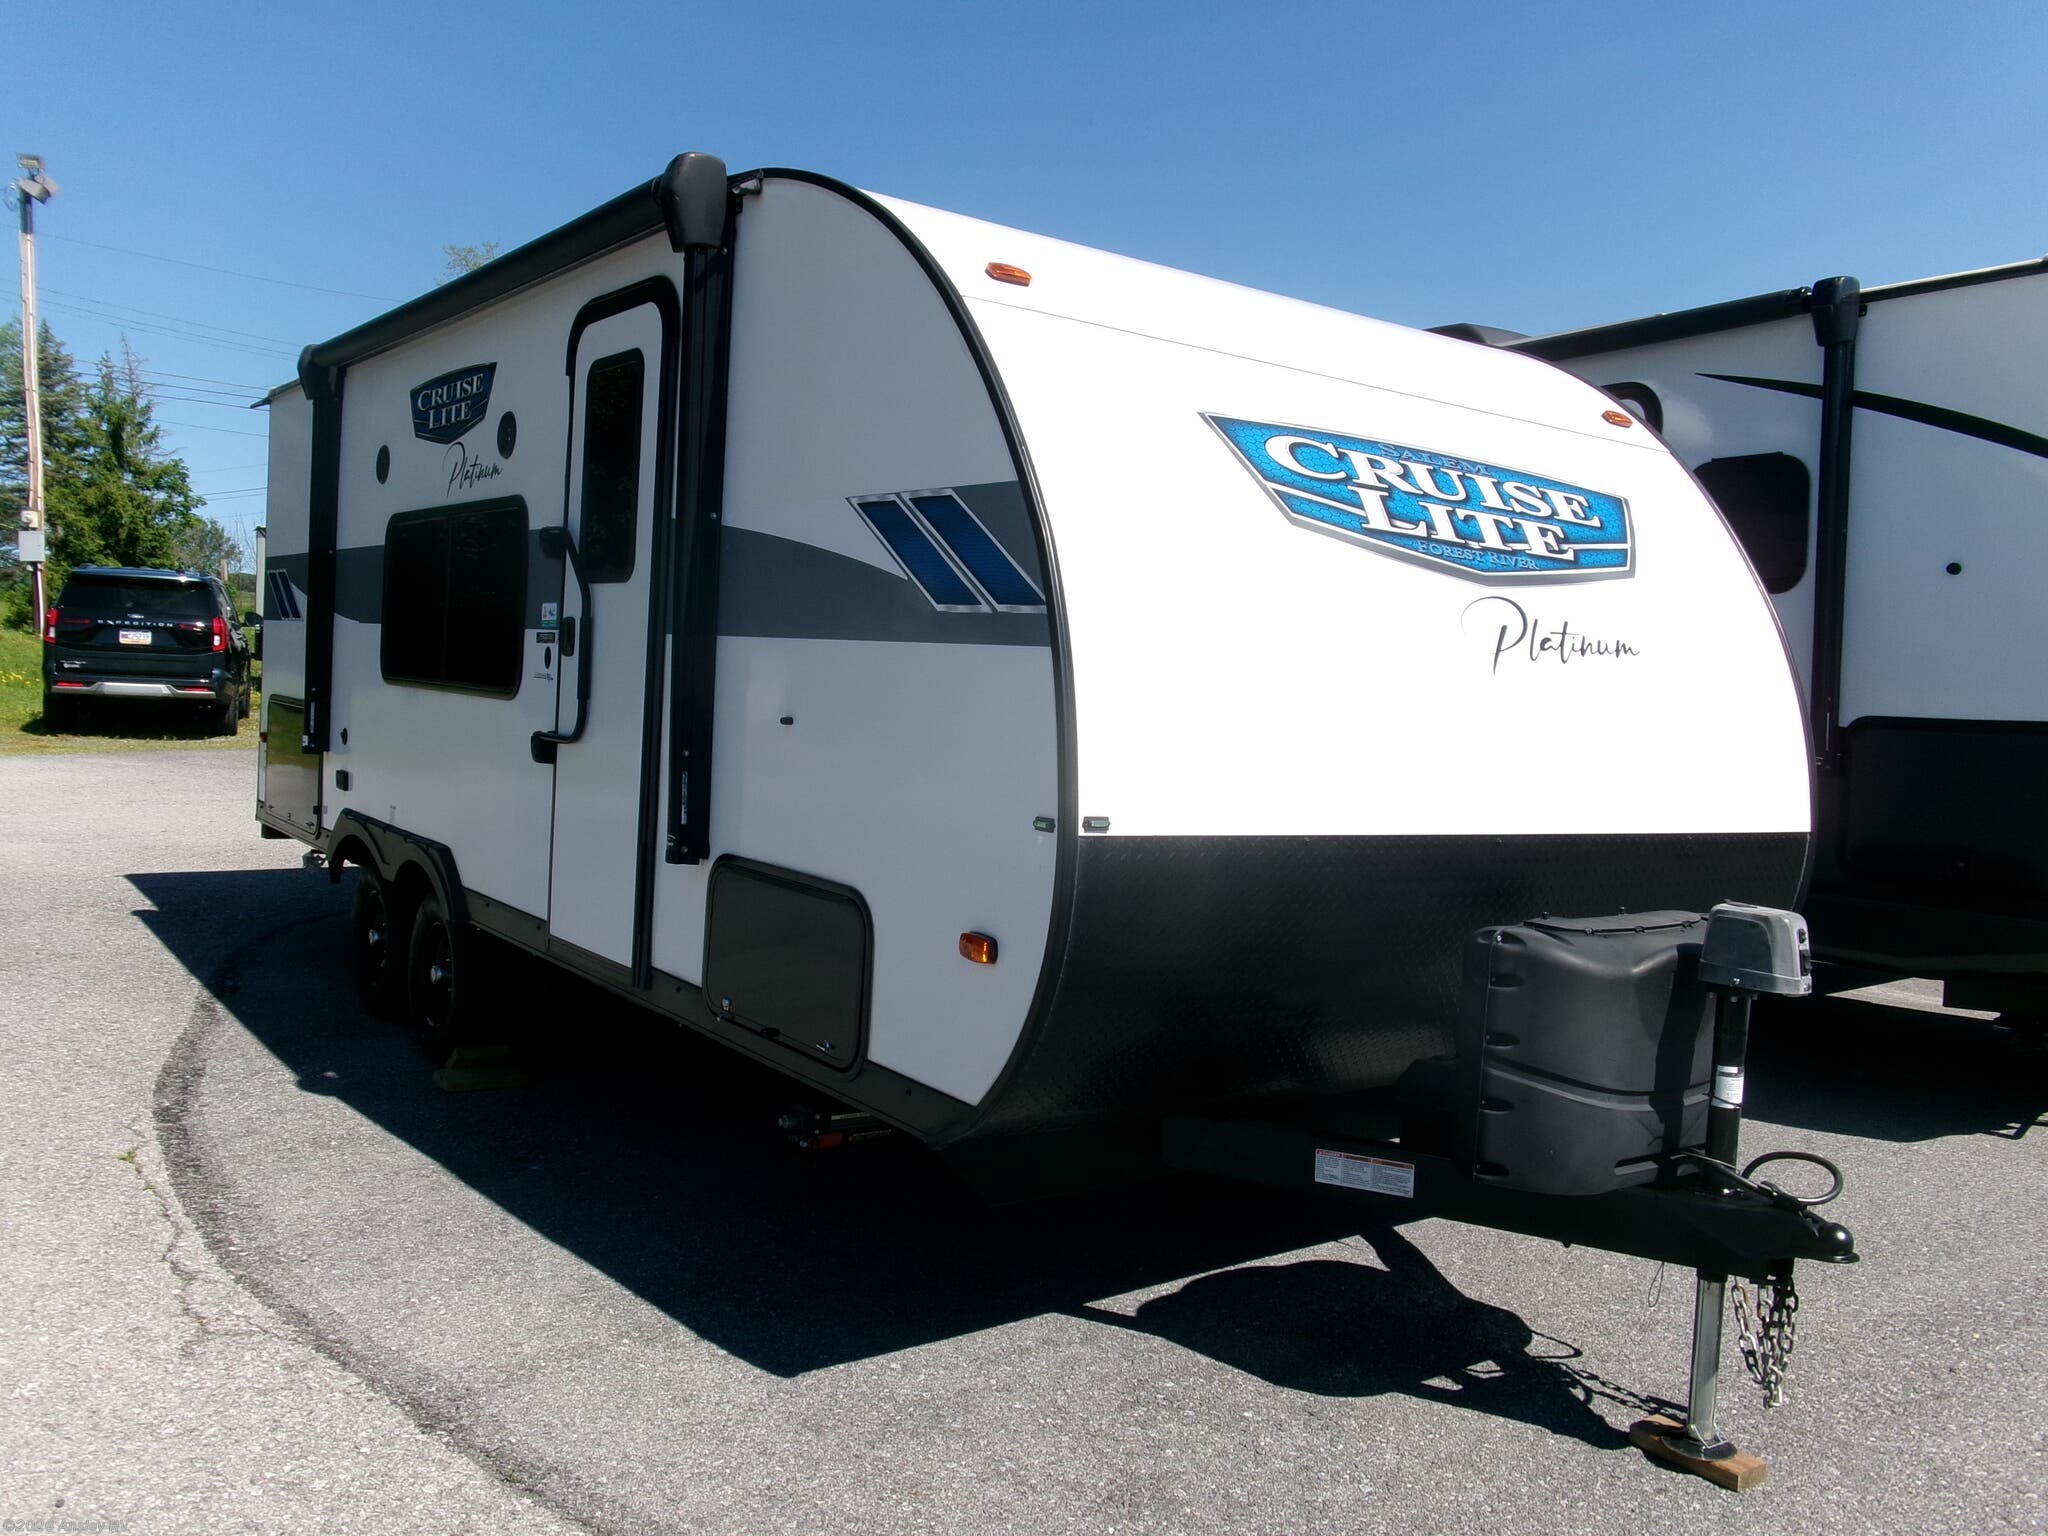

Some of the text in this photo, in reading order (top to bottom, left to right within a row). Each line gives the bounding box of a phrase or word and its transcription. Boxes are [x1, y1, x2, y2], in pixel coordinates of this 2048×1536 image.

[417, 373, 484, 411] CRUISE
[428, 400, 472, 429] LITE
[443, 441, 504, 498] Platinum
[1264, 434, 1600, 527] CRUISE
[1348, 486, 1576, 562] LITE
[1417, 539, 1540, 570] FOREST RIVER
[97, 619, 174, 627] EXPEDITION
[1461, 596, 1640, 676] Platinum
